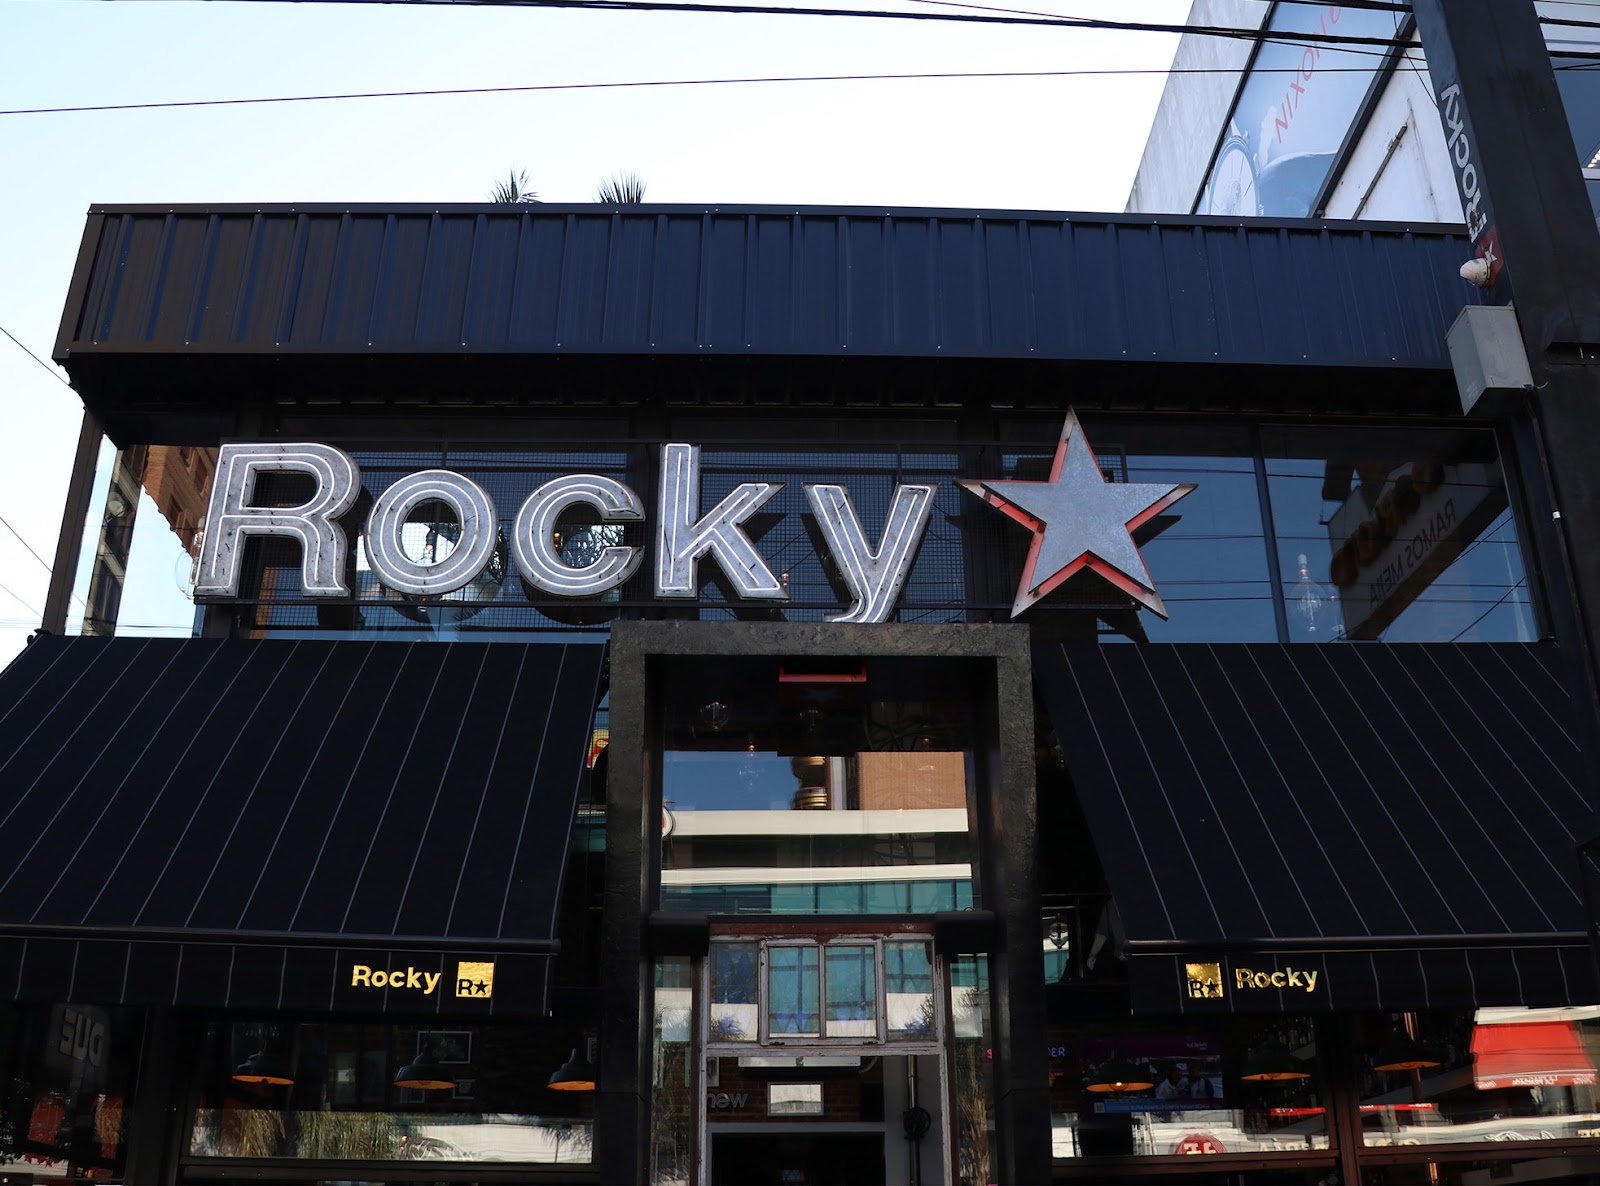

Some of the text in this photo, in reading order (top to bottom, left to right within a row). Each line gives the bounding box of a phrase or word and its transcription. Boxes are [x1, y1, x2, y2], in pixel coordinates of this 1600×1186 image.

[1440, 83, 1487, 243] Rocky
[194, 442, 938, 623] Rocky
[351, 964, 441, 995] Rocky
[1235, 967, 1318, 993] Rocky
[1047, 1046, 1066, 1057] ER
